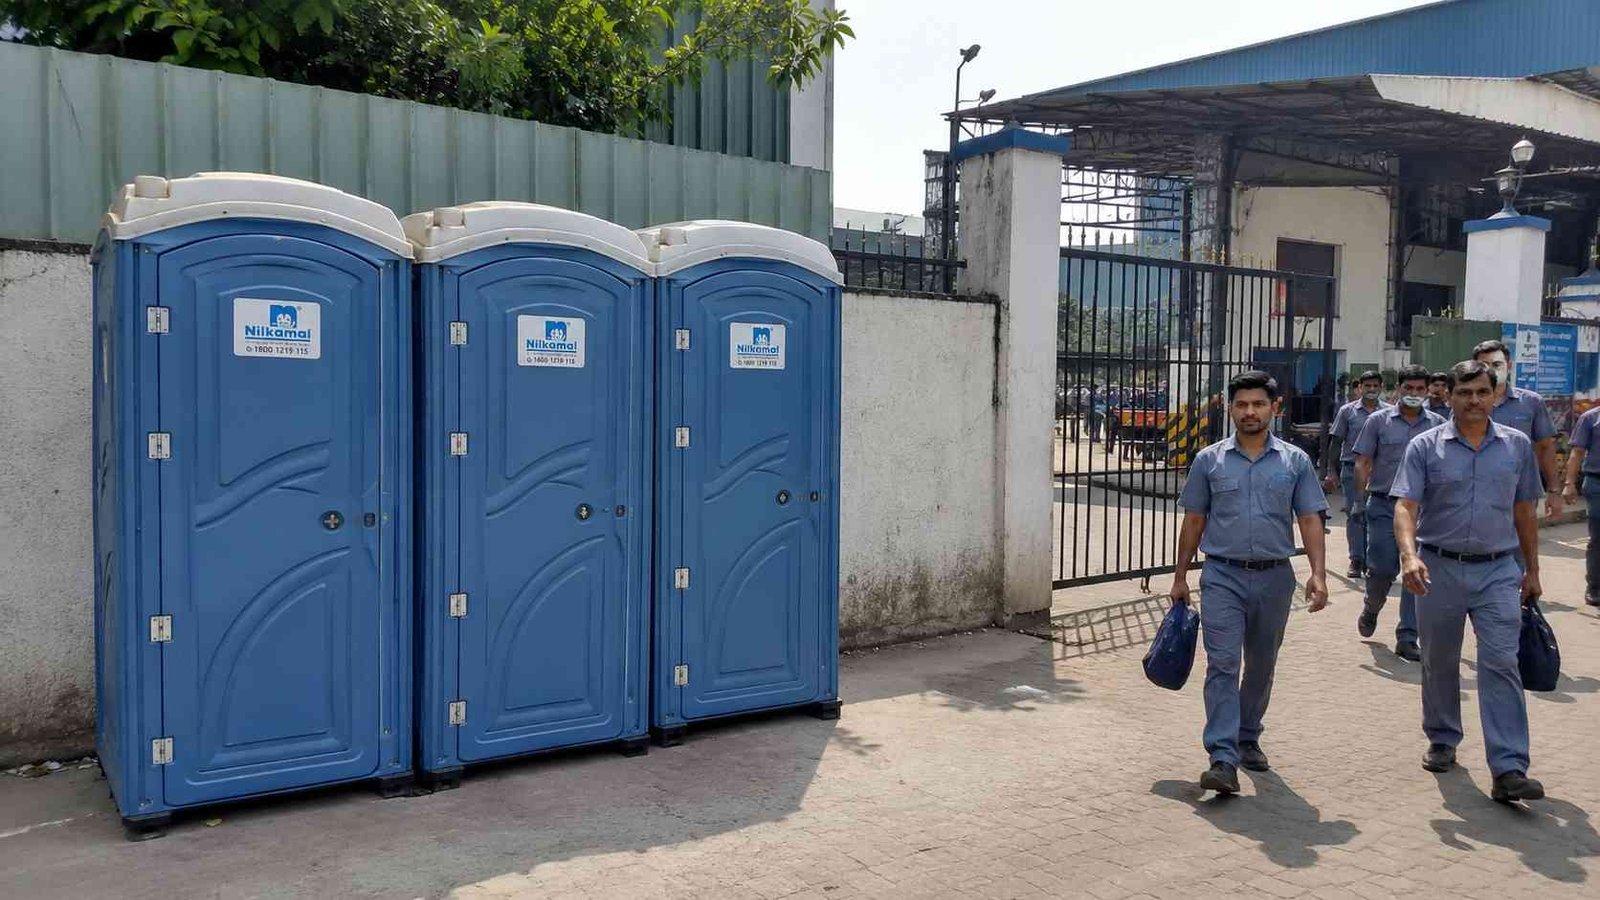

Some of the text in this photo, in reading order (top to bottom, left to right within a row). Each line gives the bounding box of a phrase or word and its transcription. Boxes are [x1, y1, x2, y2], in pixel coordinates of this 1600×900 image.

[245, 325, 311, 339] Nilkamal
[526, 339, 577, 350] Nilkamal
[737, 344, 779, 354] Nilkamal
[296, 347, 309, 355] 115
